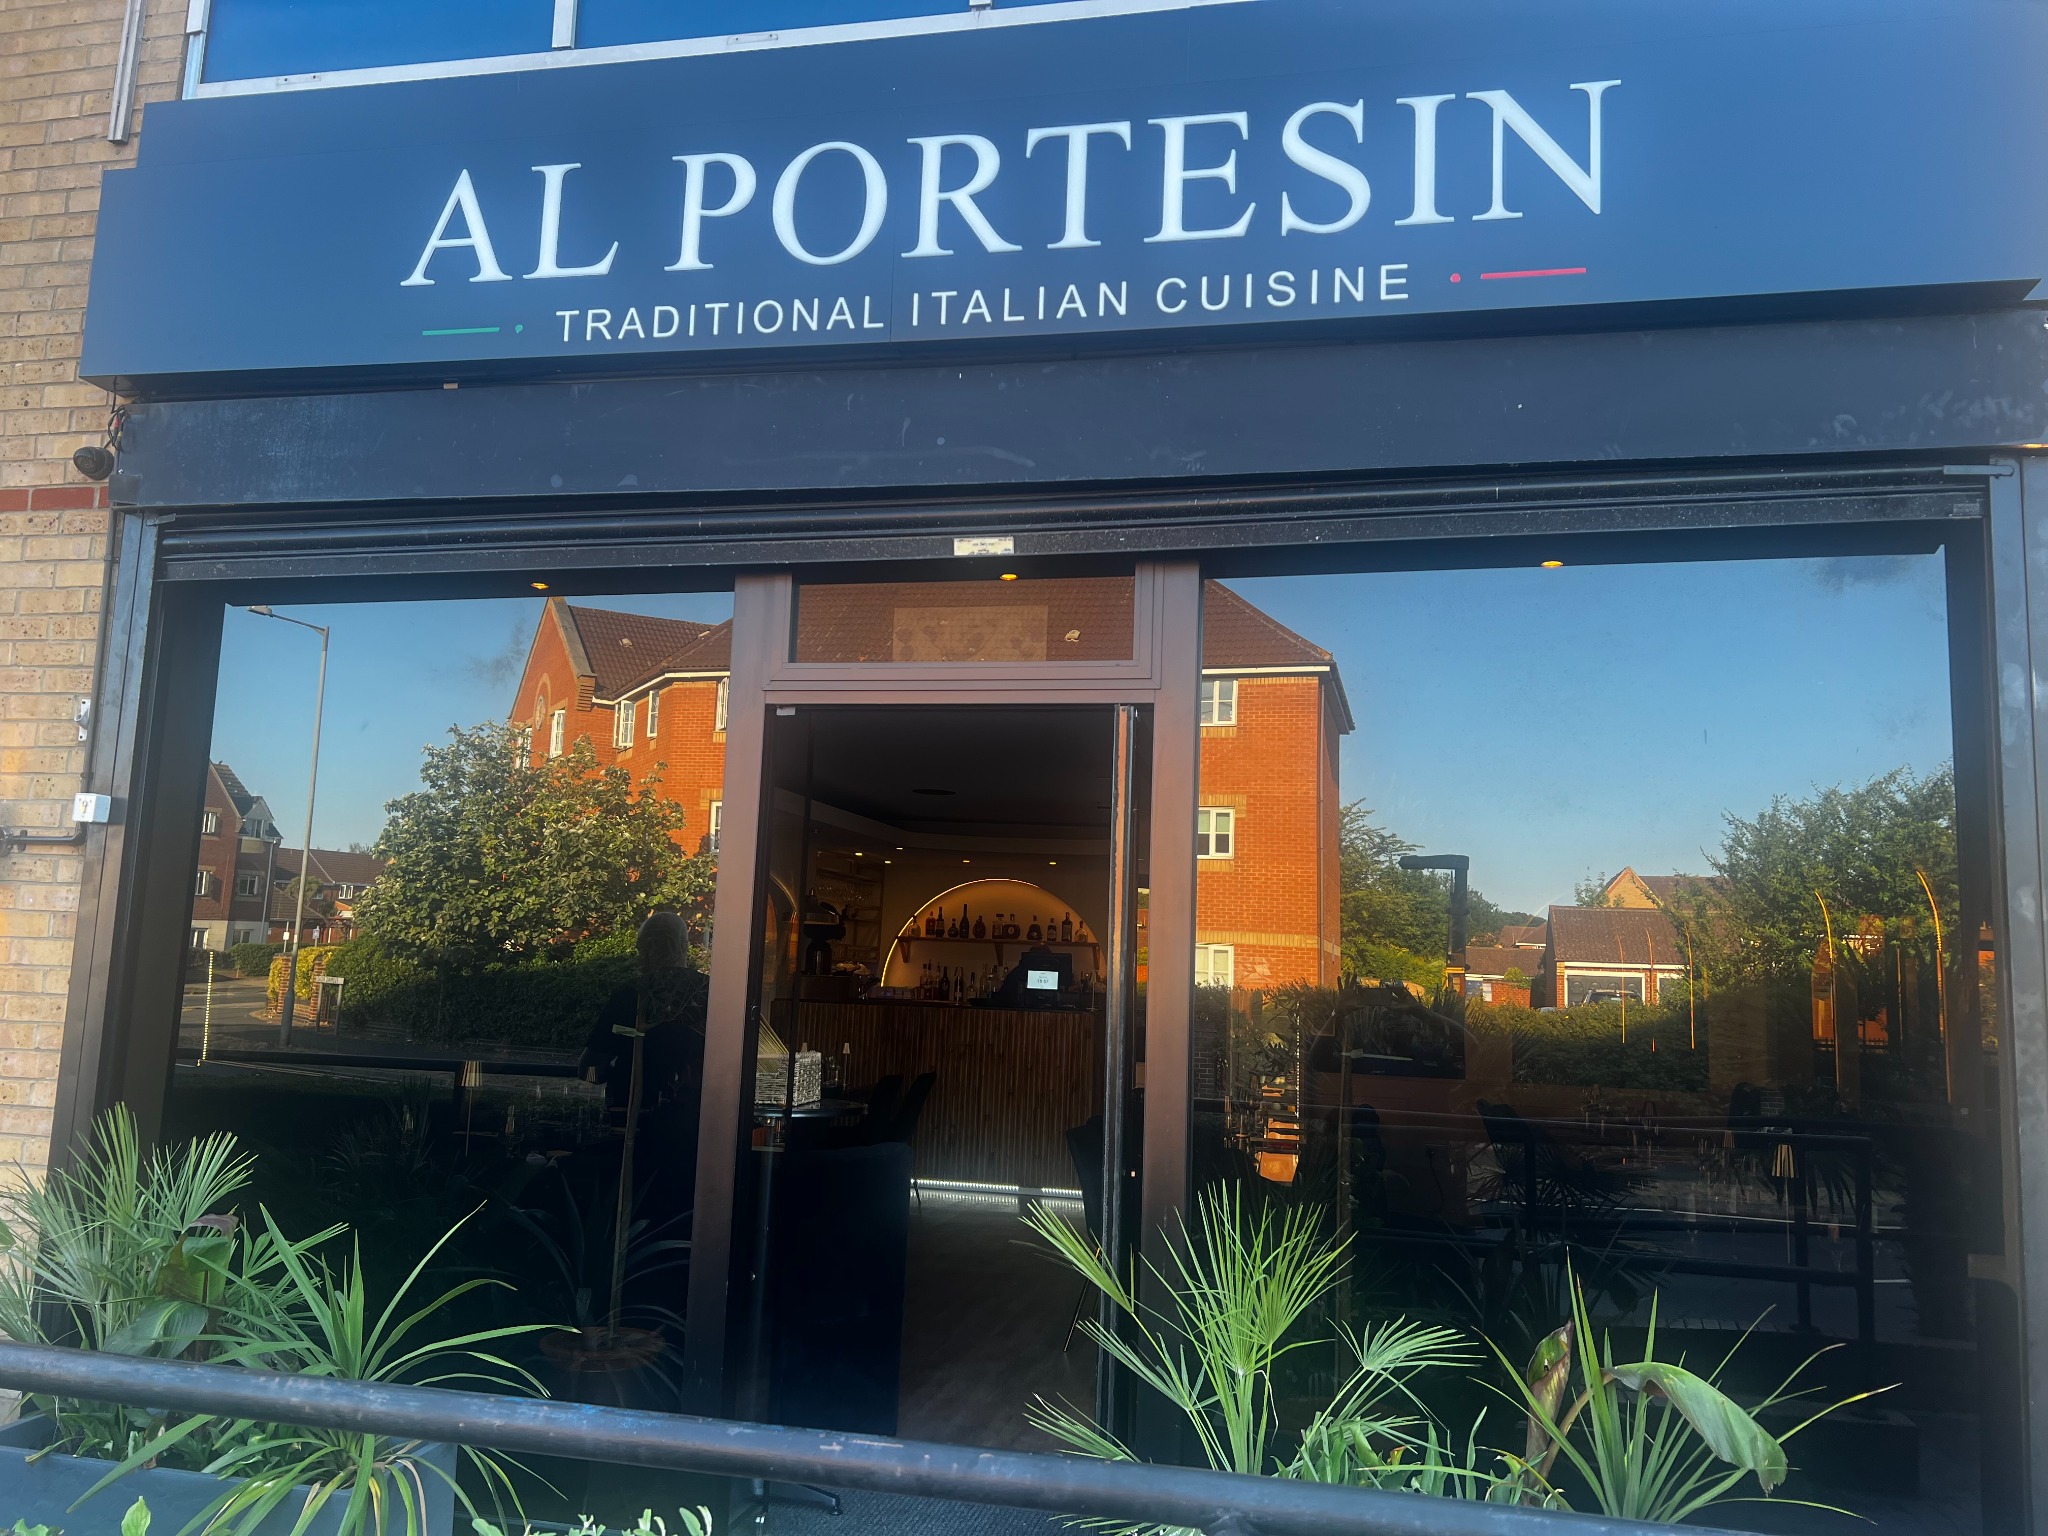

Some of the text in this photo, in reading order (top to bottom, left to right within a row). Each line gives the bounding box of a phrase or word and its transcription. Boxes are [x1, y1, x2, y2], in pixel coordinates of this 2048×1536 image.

[400, 80, 1622, 287] AL PORTESIN
[556, 263, 1410, 342] TRADITIONAL ITALIAN CUISINE
